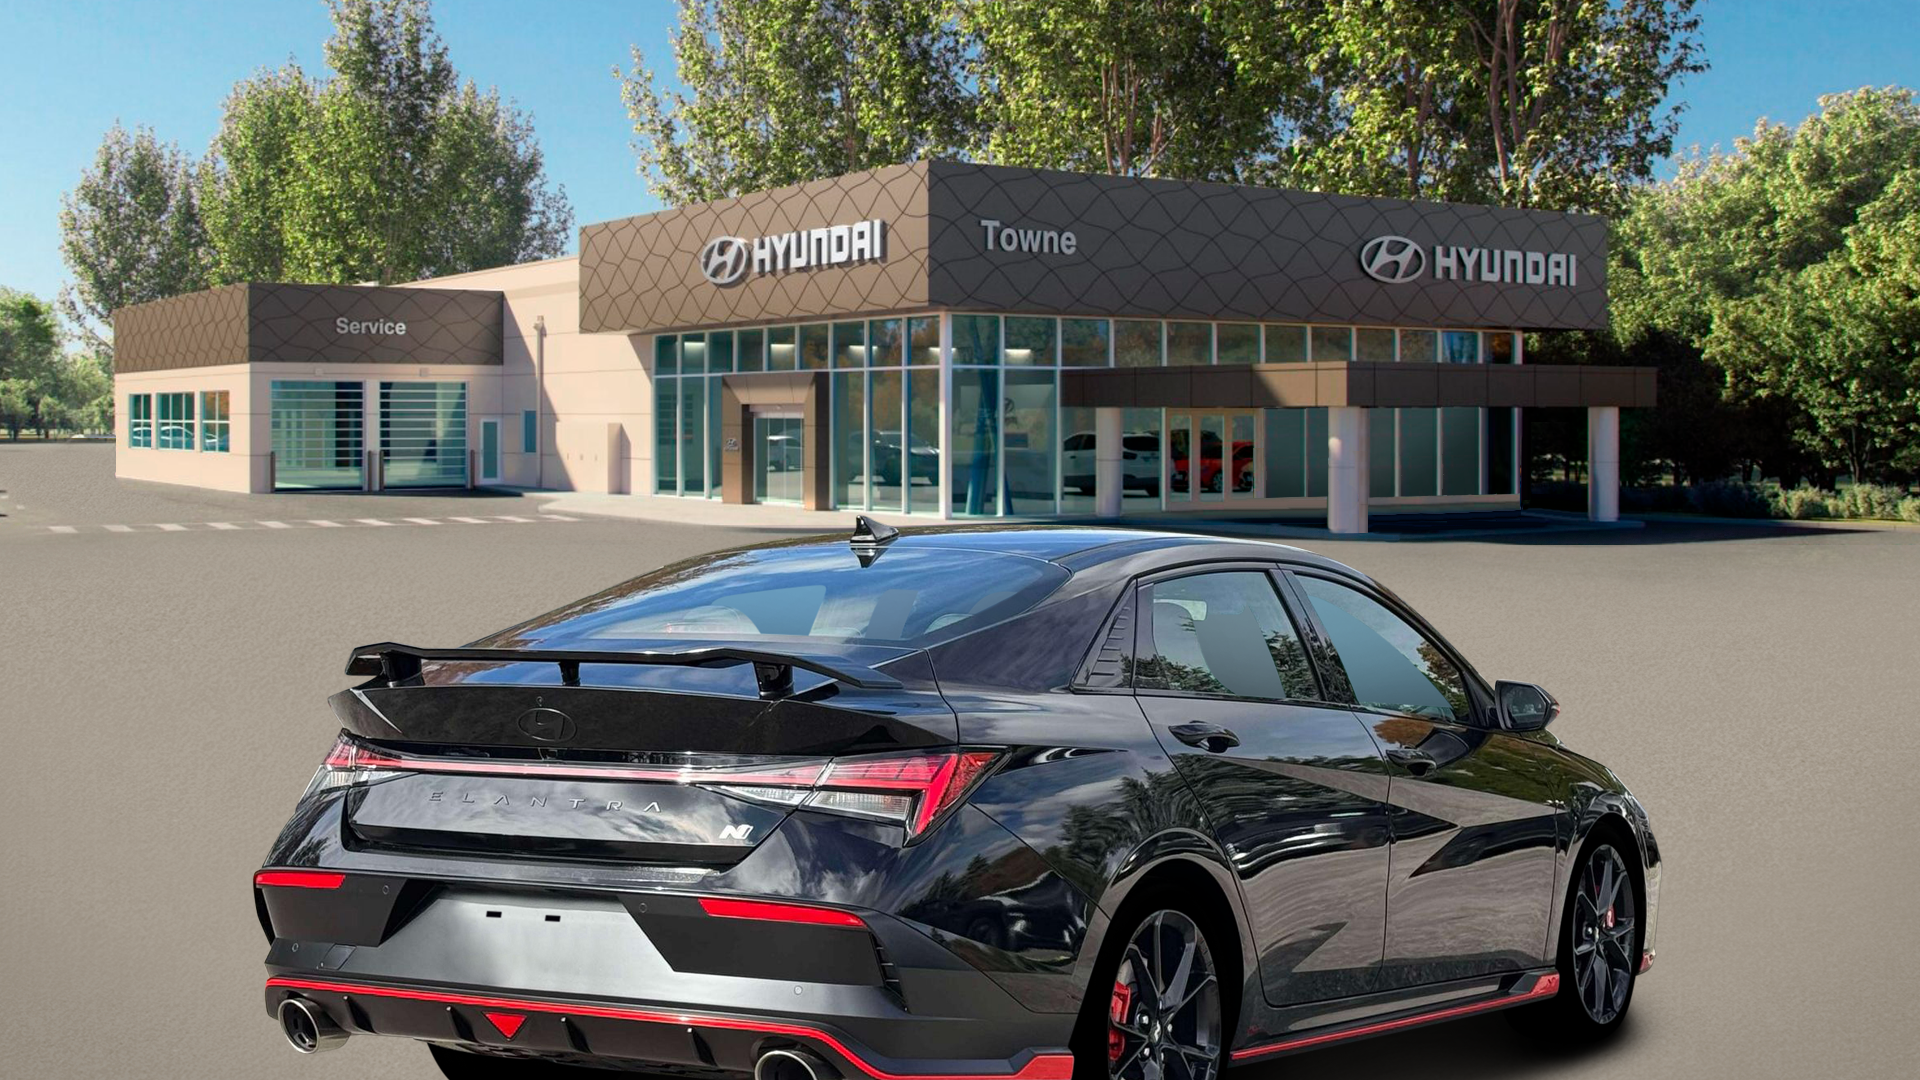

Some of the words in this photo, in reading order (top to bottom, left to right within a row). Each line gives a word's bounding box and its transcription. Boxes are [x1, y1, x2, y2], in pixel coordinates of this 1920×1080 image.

[752, 219, 881, 273] HYUNDAI
[980, 219, 1077, 255] Towne
[1435, 245, 1577, 287] HYUNDAI
[335, 317, 407, 335] Service
[429, 791, 661, 813] ELANTRA
